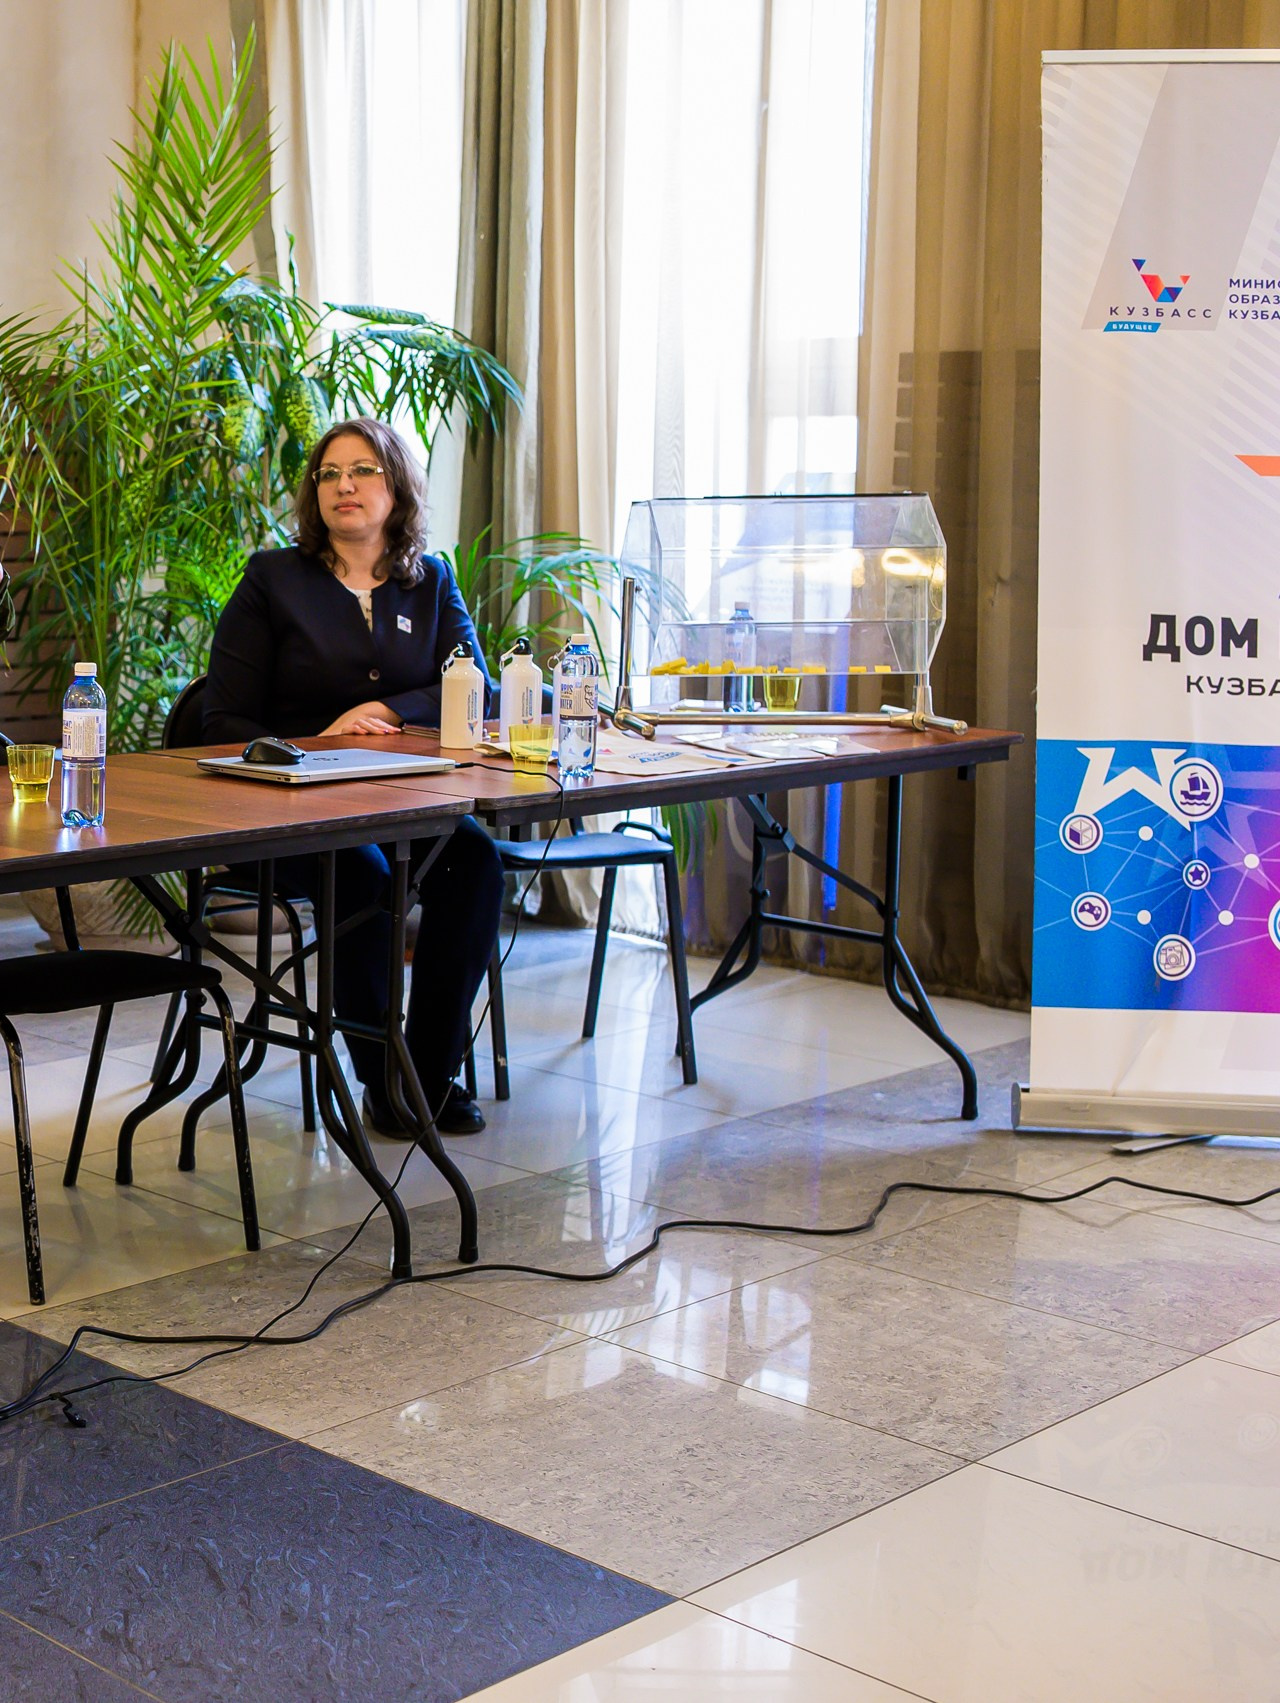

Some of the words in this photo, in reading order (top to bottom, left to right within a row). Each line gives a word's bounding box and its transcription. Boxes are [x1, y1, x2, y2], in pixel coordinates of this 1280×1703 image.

[1229, 278, 1280, 289] МИНИ
[1229, 294, 1280, 305] ОБРАЗ
[1109, 306, 1212, 319] КУЗБАСС
[1228, 309, 1280, 320] КУЗБА
[1112, 323, 1153, 331] БУДУЩЕЕ
[1142, 613, 1259, 663] ДОМ
